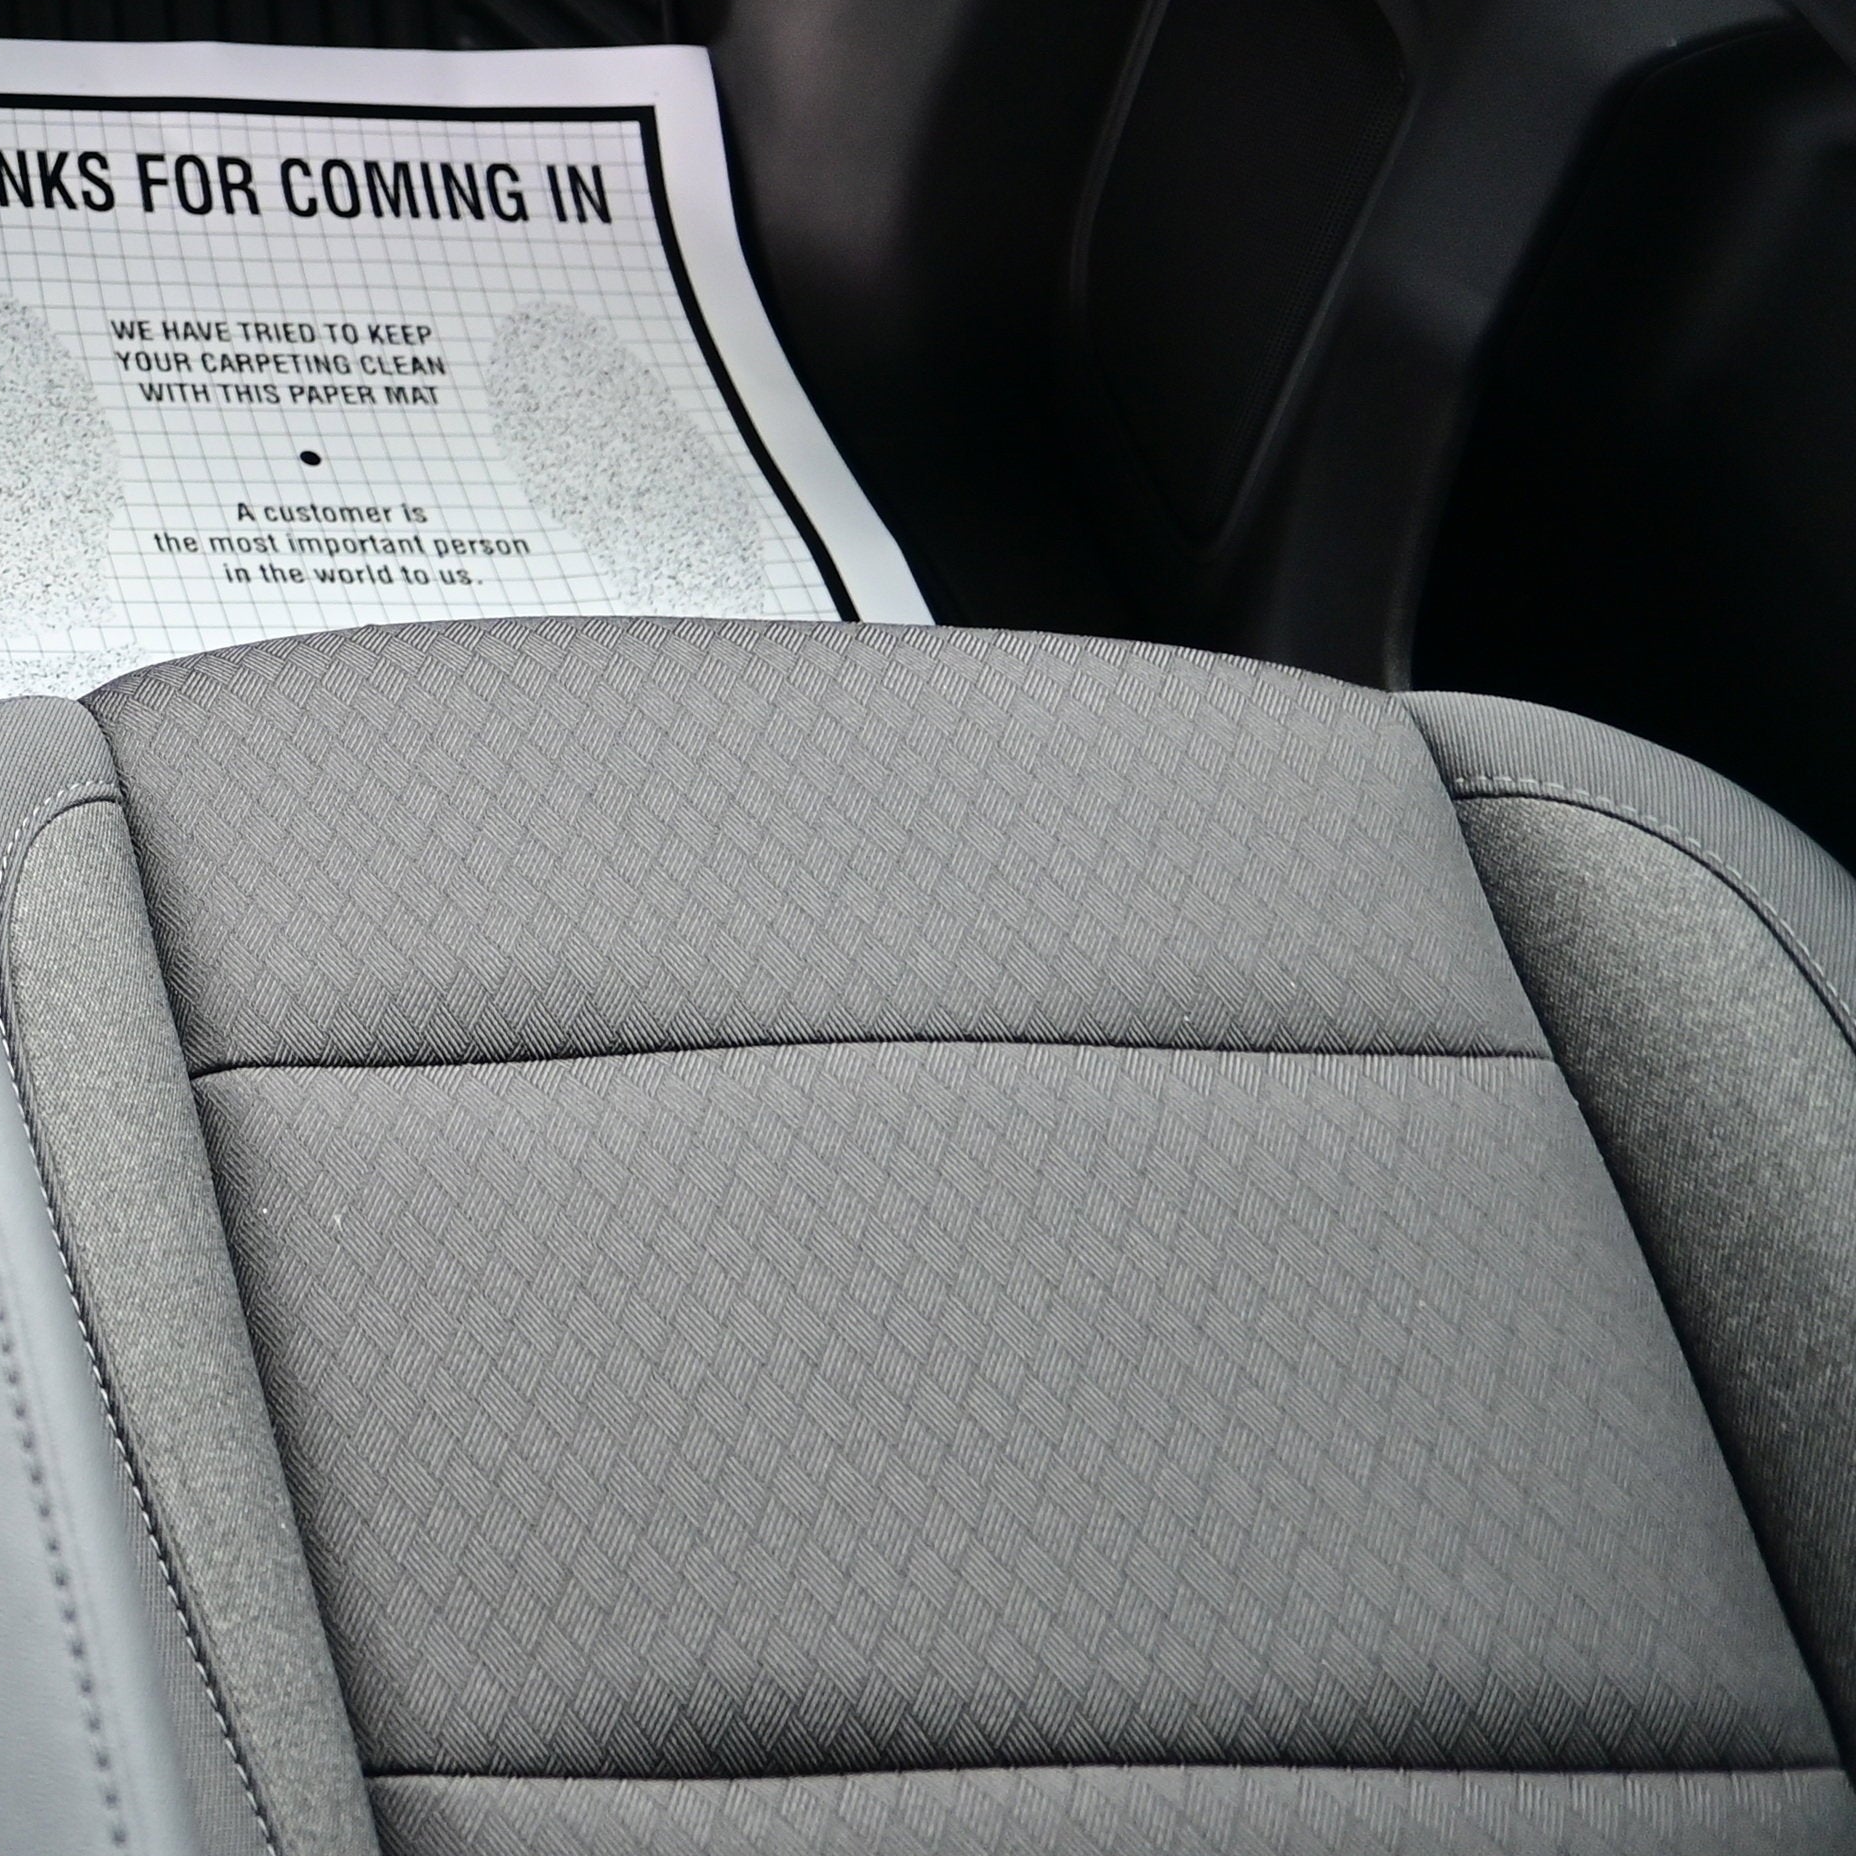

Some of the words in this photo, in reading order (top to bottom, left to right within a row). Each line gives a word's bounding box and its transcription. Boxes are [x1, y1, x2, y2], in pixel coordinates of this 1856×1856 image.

[137, 154, 260, 215] FOR
[281, 158, 529, 222] COMING
[547, 165, 611, 224] IN
[111, 321, 152, 340] WE
[162, 322, 229, 341] HAVE
[239, 323, 315, 343] TRIED
[325, 324, 358, 344] TO
[368, 325, 431, 345] KEEP
[116, 352, 191, 372] YOUR
[201, 353, 350, 374] CARPETING
[360, 356, 445, 375] CLEAN
[139, 383, 210, 402] WITH
[219, 384, 280, 403] THIS
[289, 385, 375, 404] PAPER
[384, 386, 437, 404] MAT
[238, 503, 255, 521] A
[264, 504, 390, 522] customer
[402, 503, 427, 522] is
[154, 532, 198, 552] the
[210, 535, 278, 553] most
[288, 535, 424, 557] important
[434, 540, 529, 557] person
[226, 568, 251, 582] in
[260, 564, 304, 583] the
[314, 565, 393, 584] world
[401, 566, 429, 584] to
[439, 570, 483, 585] us.
